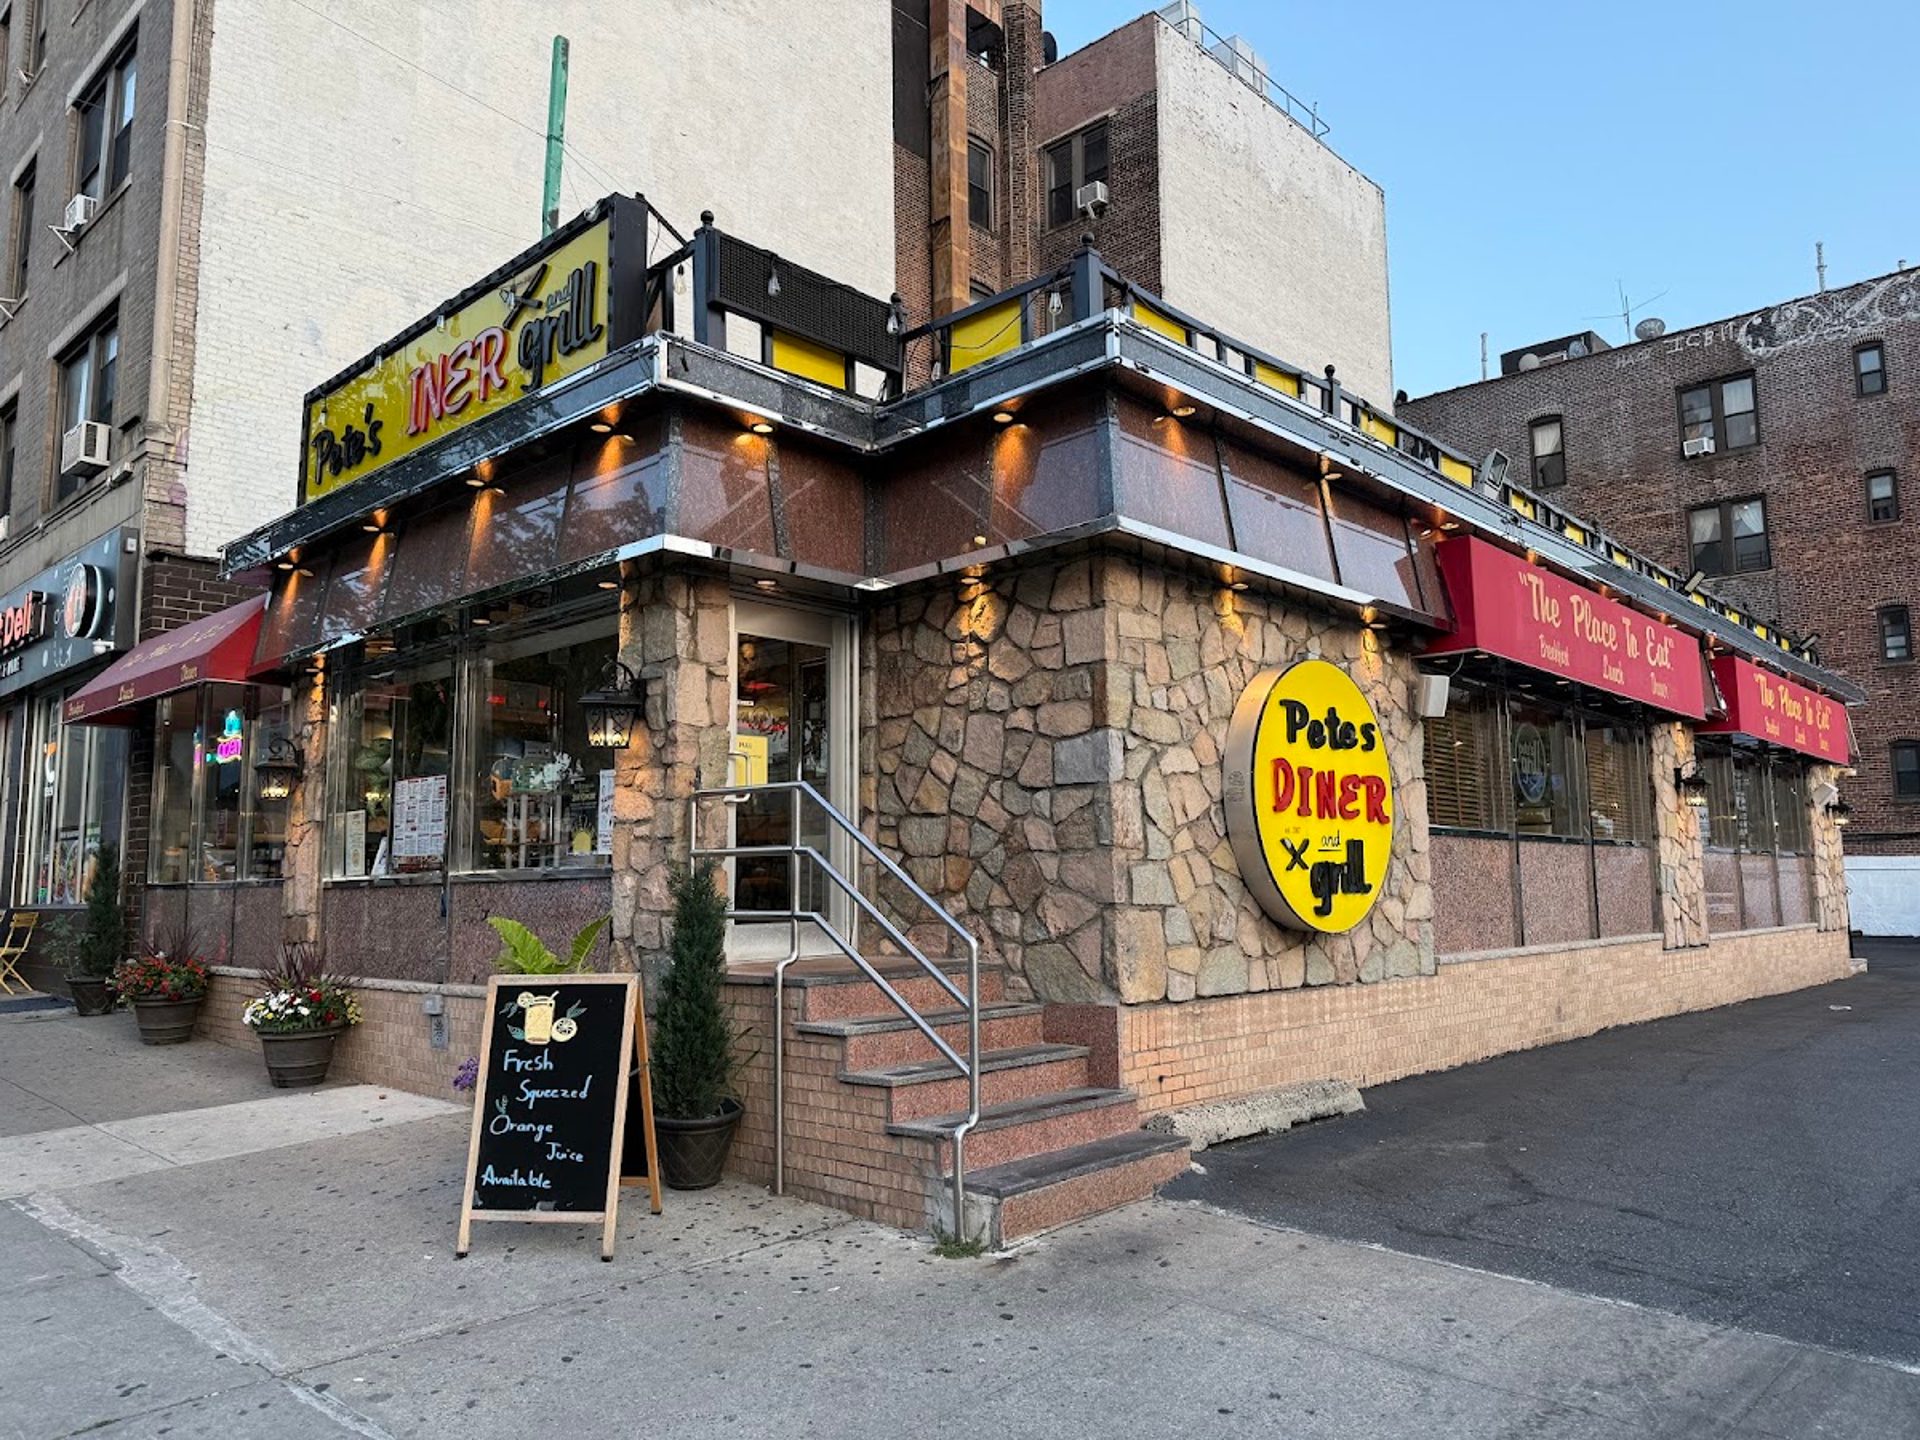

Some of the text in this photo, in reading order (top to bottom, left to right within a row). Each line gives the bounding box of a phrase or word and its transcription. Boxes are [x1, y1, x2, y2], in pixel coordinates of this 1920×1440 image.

[546, 281, 574, 313] and
[311, 260, 603, 485] Pete's INER grill
[2, 591, 33, 648] Deli
[1570, 594, 1618, 651] Place
[1622, 617, 1640, 658] To
[1778, 684, 1802, 722] Place
[1279, 699, 1376, 752] Petes
[1270, 758, 1390, 825] DINER
[1320, 829, 1341, 848] and
[1310, 838, 1372, 917] grill
[503, 1049, 554, 1072] Fresh
[515, 1075, 593, 1110] Squeezed
[489, 1114, 554, 1142] Orange
[546, 1142, 584, 1162] Juice
[480, 1164, 552, 1189] Available
